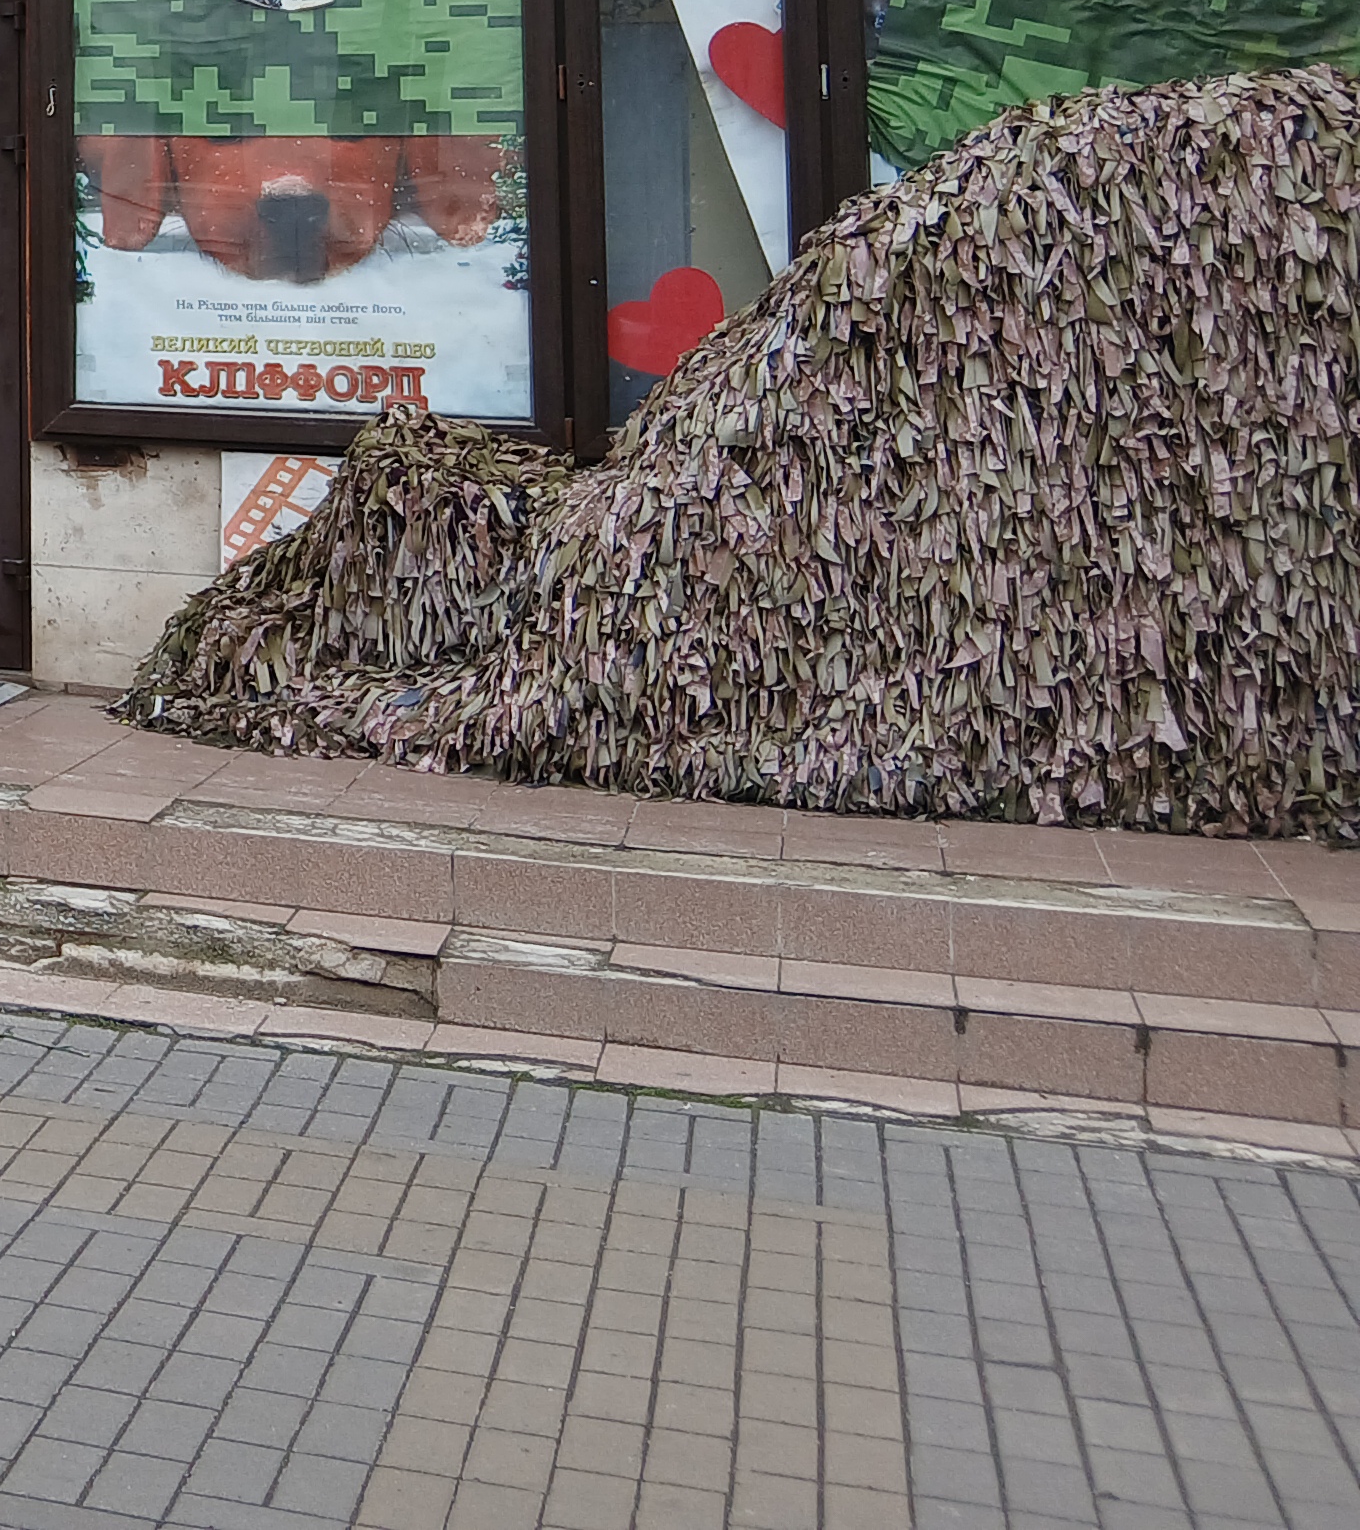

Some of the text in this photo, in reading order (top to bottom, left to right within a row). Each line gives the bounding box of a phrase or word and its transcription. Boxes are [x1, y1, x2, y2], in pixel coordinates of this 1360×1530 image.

[176, 299, 194, 310] На
[271, 301, 317, 313] більше
[320, 302, 368, 314] любите
[330, 315, 359, 325] стає
[150, 334, 437, 359] ВЕЛИКИЙ ЧЕРВОНИЙ ПЕС
[157, 359, 429, 412] КЛІФФОРД
